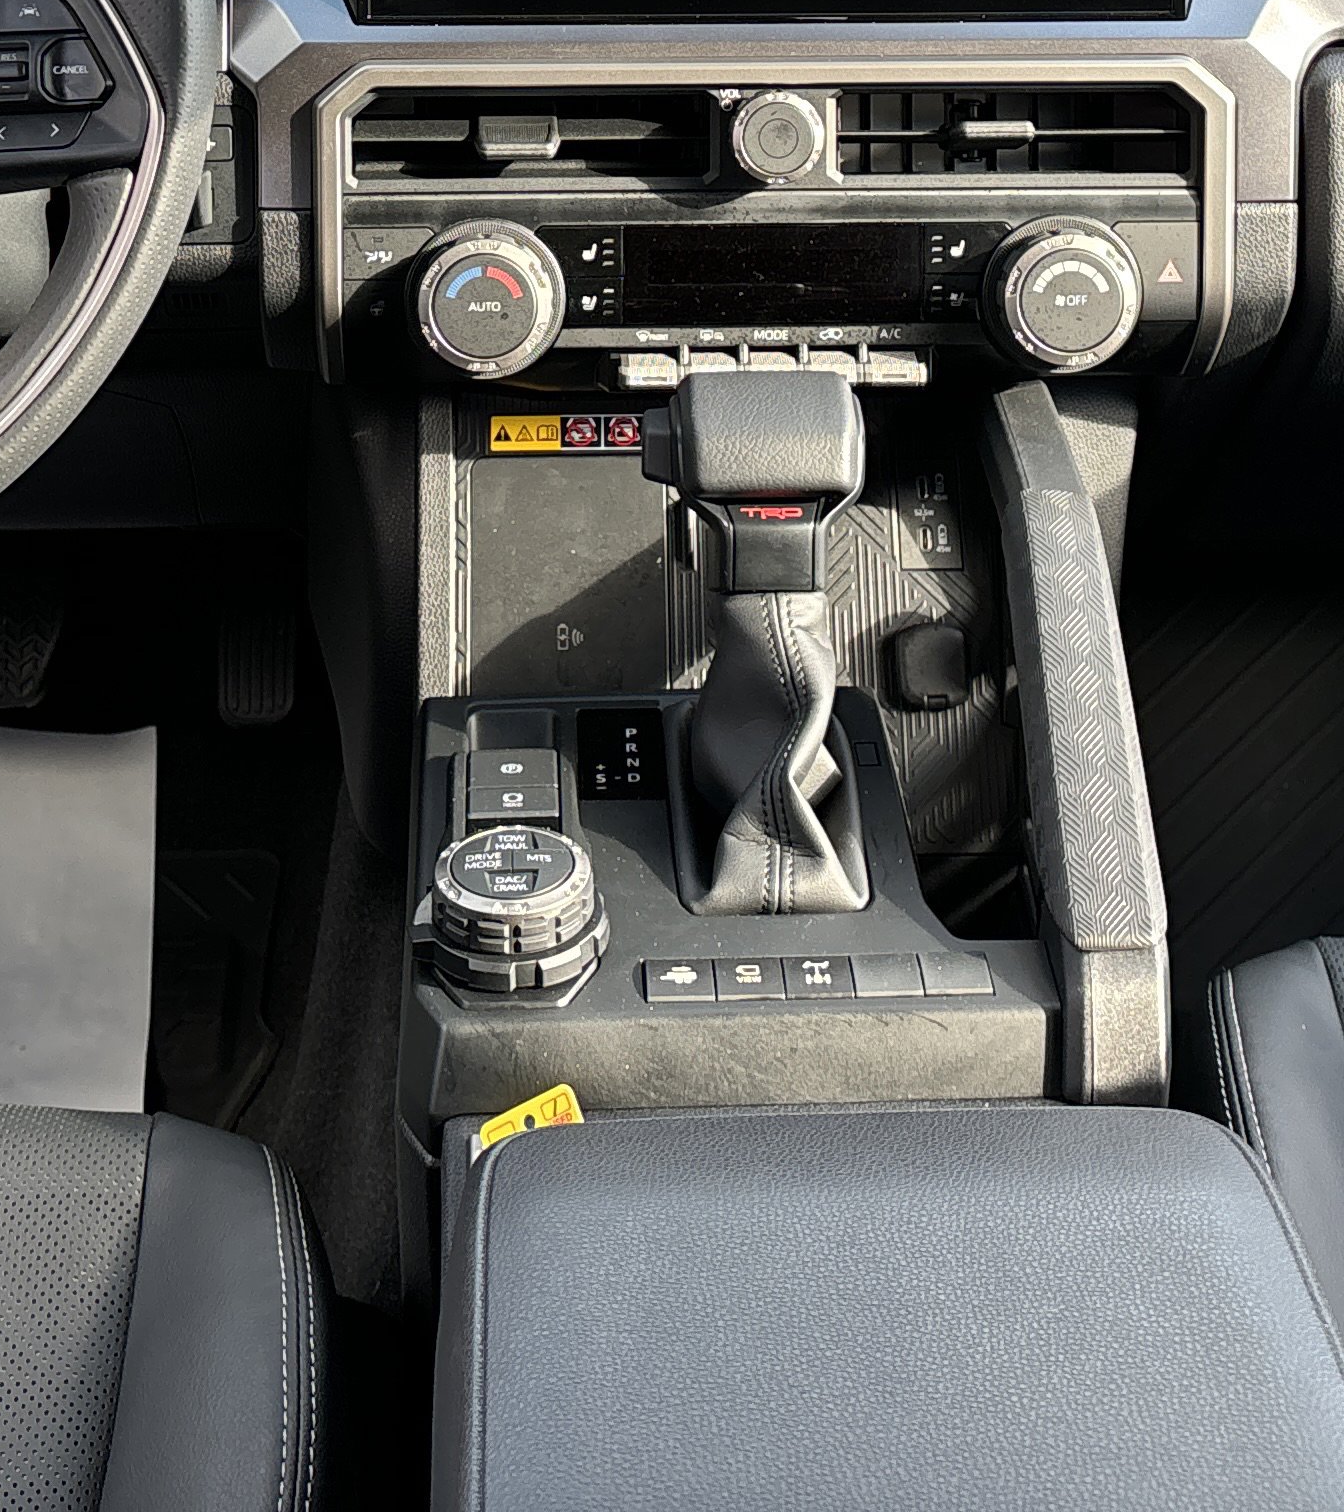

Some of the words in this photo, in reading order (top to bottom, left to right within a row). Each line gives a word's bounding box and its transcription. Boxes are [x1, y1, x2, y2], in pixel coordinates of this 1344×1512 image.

[53, 65, 89, 75] CANCEL
[720, 88, 742, 99] VOL
[1066, 294, 1088, 306] OFF
[468, 301, 502, 312] AUTO
[753, 329, 788, 341] MODE
[879, 328, 902, 340] A/C
[739, 507, 803, 520] TRD
[625, 727, 638, 738] P
[625, 742, 638, 753] R
[626, 757, 640, 767] N
[596, 773, 607, 784] S
[627, 772, 640, 783] D
[497, 834, 527, 842] TOW
[494, 842, 528, 850] HAUL
[465, 851, 503, 863] DRIVE
[526, 854, 552, 863] MTS
[464, 859, 503, 871] MODE
[493, 883, 529, 893] CRAWL
[736, 975, 762, 984] VIEW
